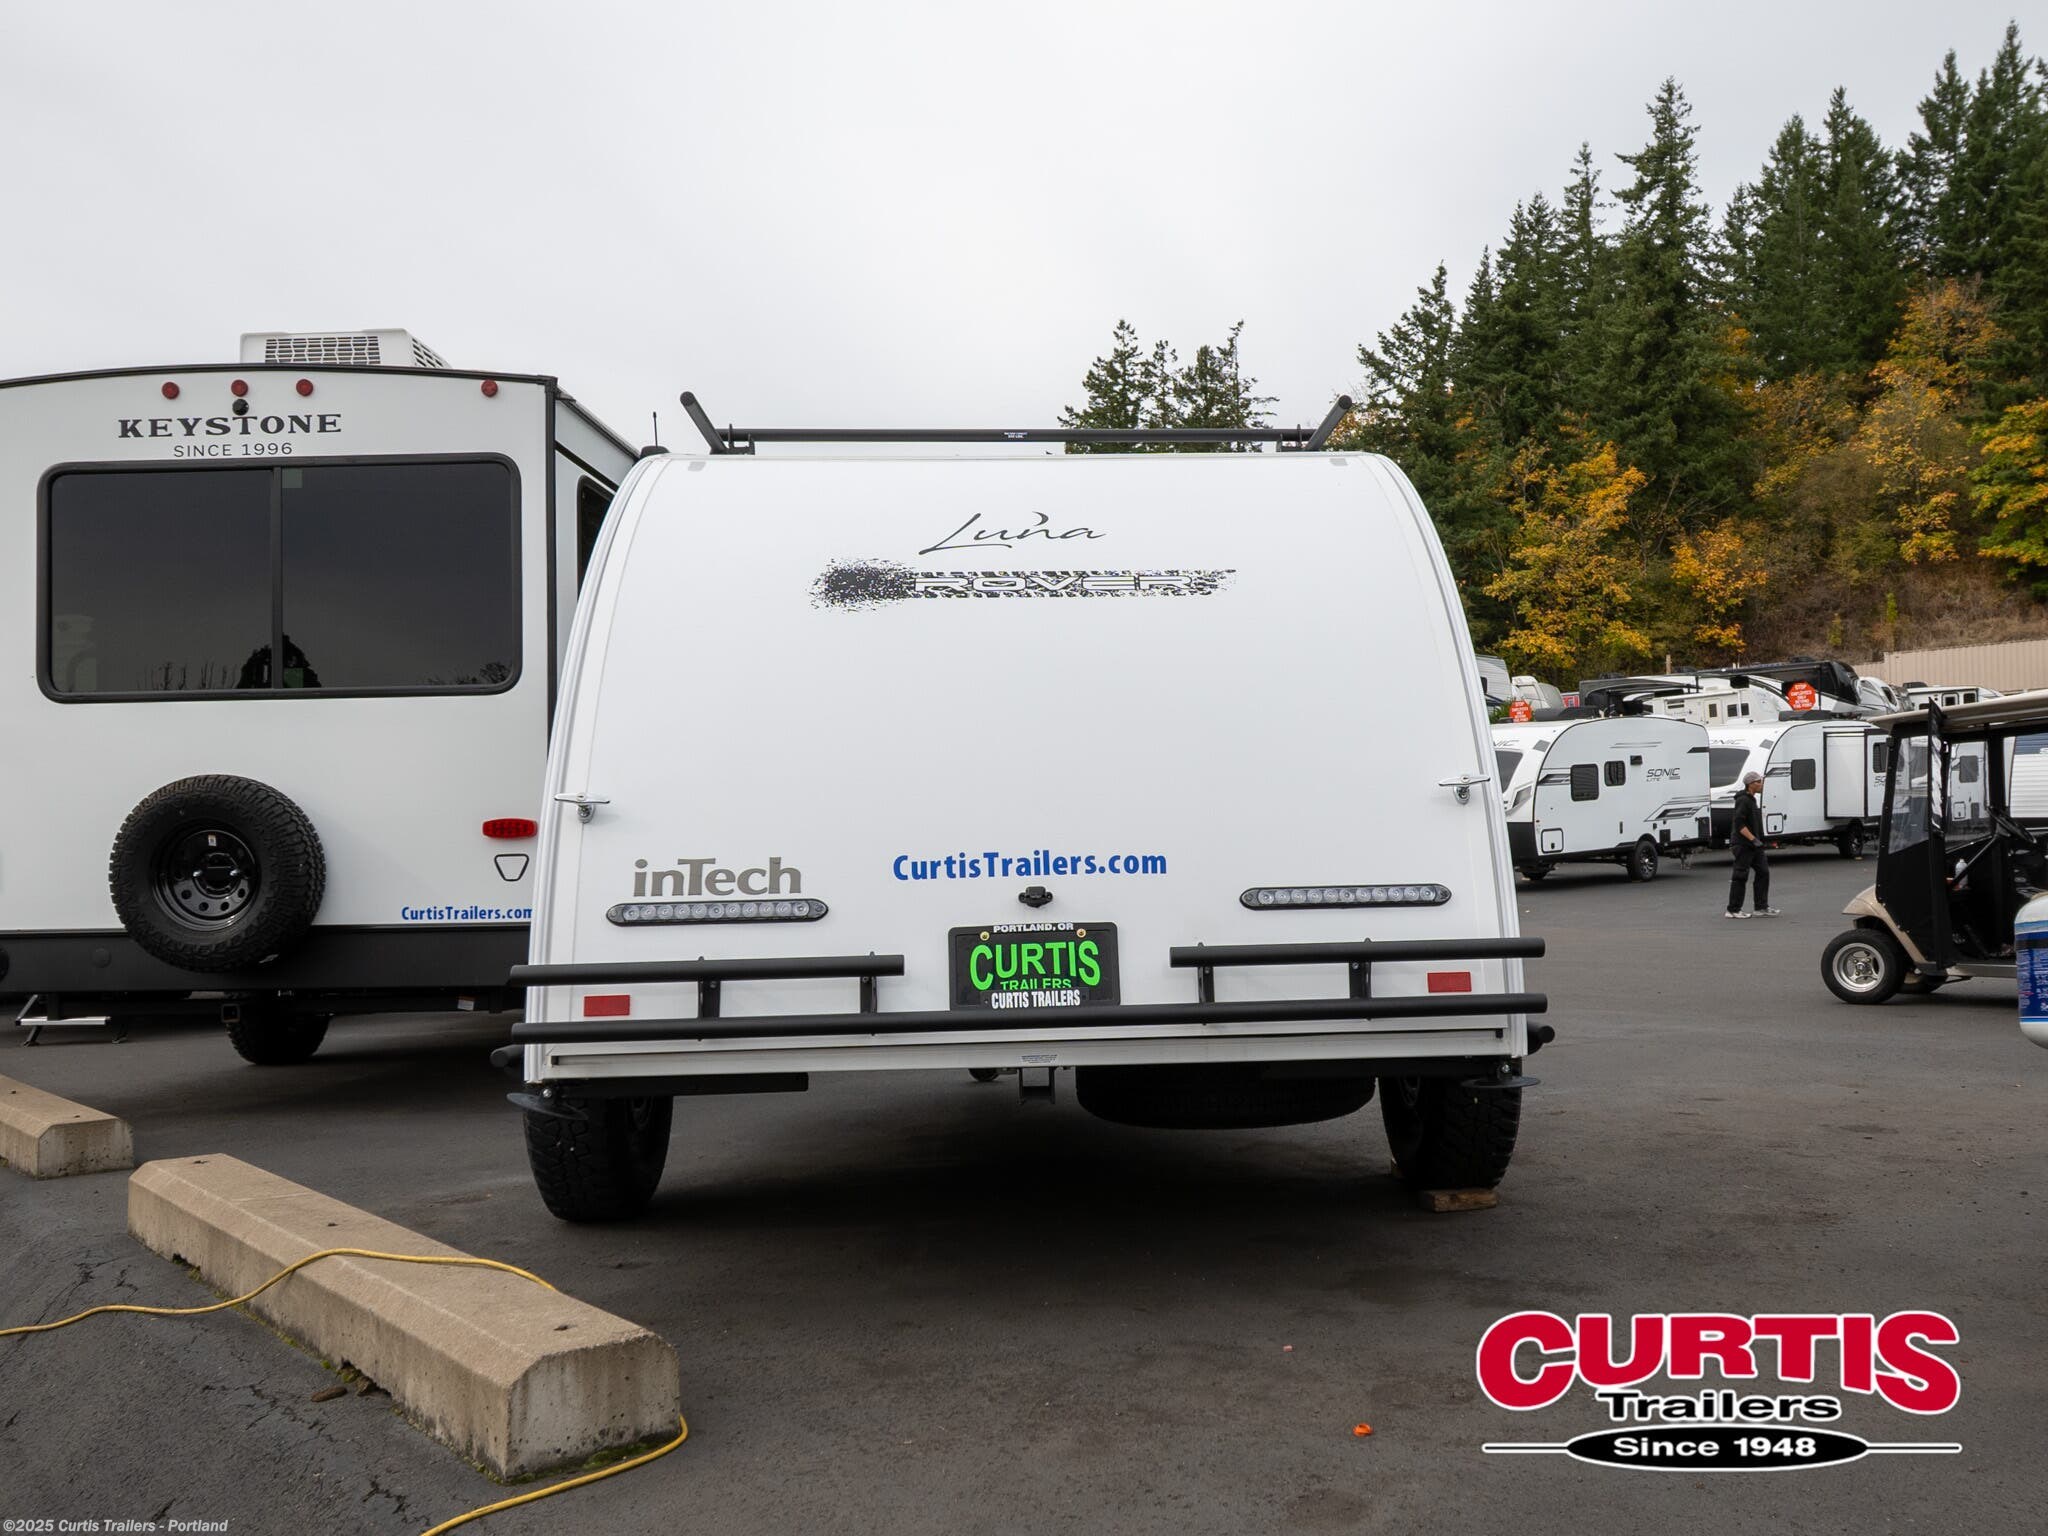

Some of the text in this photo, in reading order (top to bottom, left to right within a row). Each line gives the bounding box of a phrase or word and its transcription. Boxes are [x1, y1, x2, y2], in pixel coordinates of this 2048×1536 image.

[118, 413, 342, 439] KEYSTONE
[173, 442, 293, 457] SINCE 1996
[918, 512, 1106, 556] Luna
[914, 575, 1194, 593] ROVER
[1646, 767, 1680, 778] SONIC
[633, 857, 801, 897] inTech
[893, 850, 1168, 881] CurtisTrailers.com
[993, 922, 1074, 933] PORTLAND, OR
[970, 940, 1101, 991] CURTIS
[991, 989, 1080, 1009] CURTIS TRAILERS
